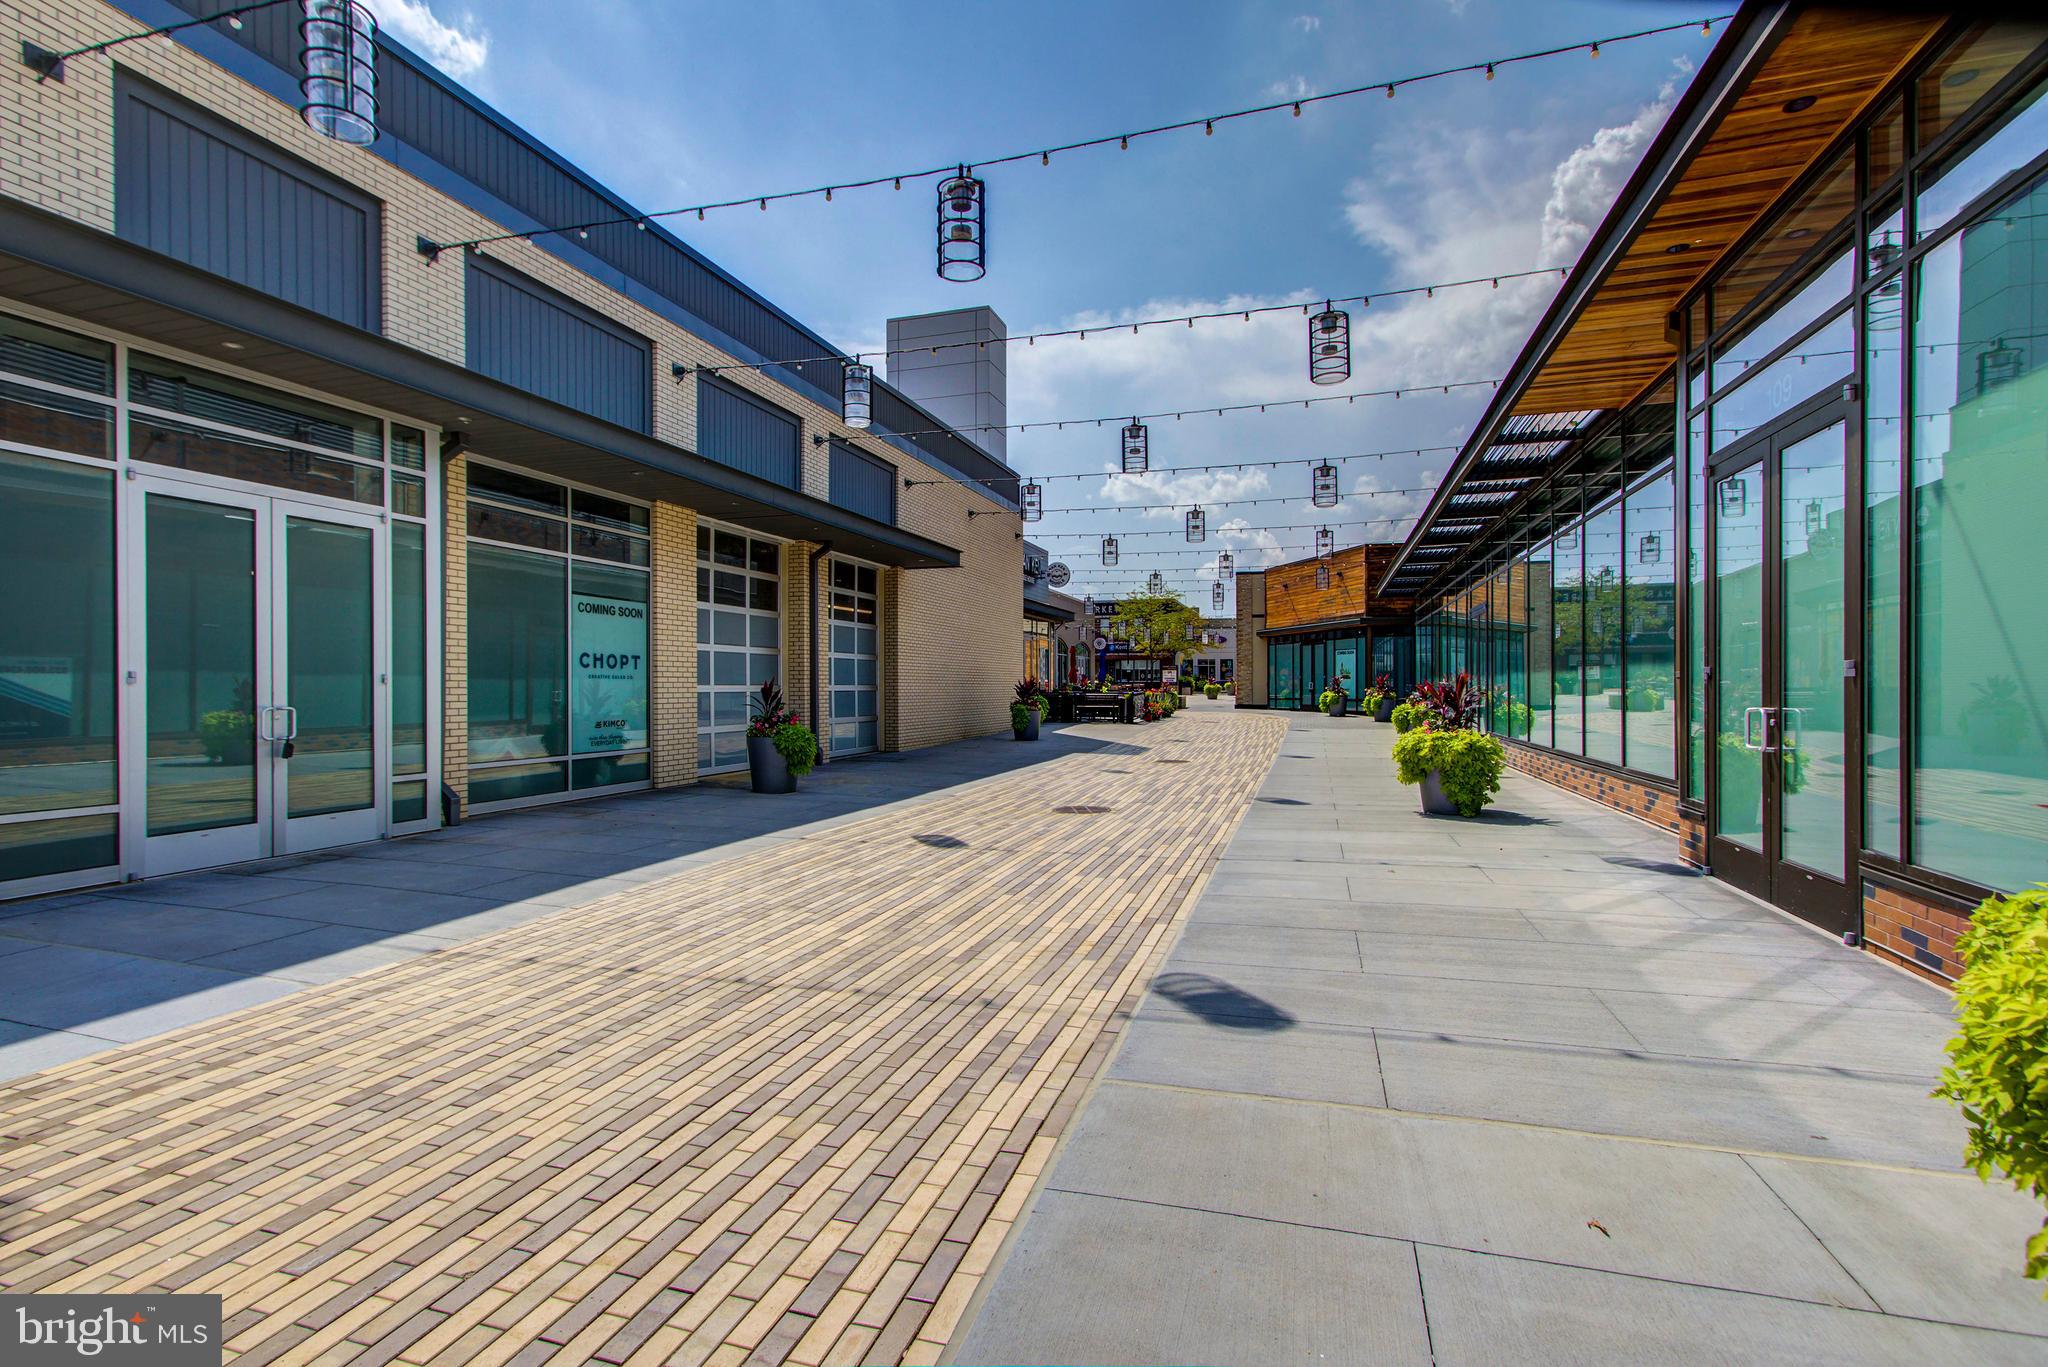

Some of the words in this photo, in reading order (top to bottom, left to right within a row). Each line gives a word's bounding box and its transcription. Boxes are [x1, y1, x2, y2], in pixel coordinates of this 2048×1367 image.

[577, 602, 616, 616] COMING
[617, 606, 643, 619] SOON
[579, 652, 641, 671] CHOPT
[603, 719, 626, 728] KIMCO
